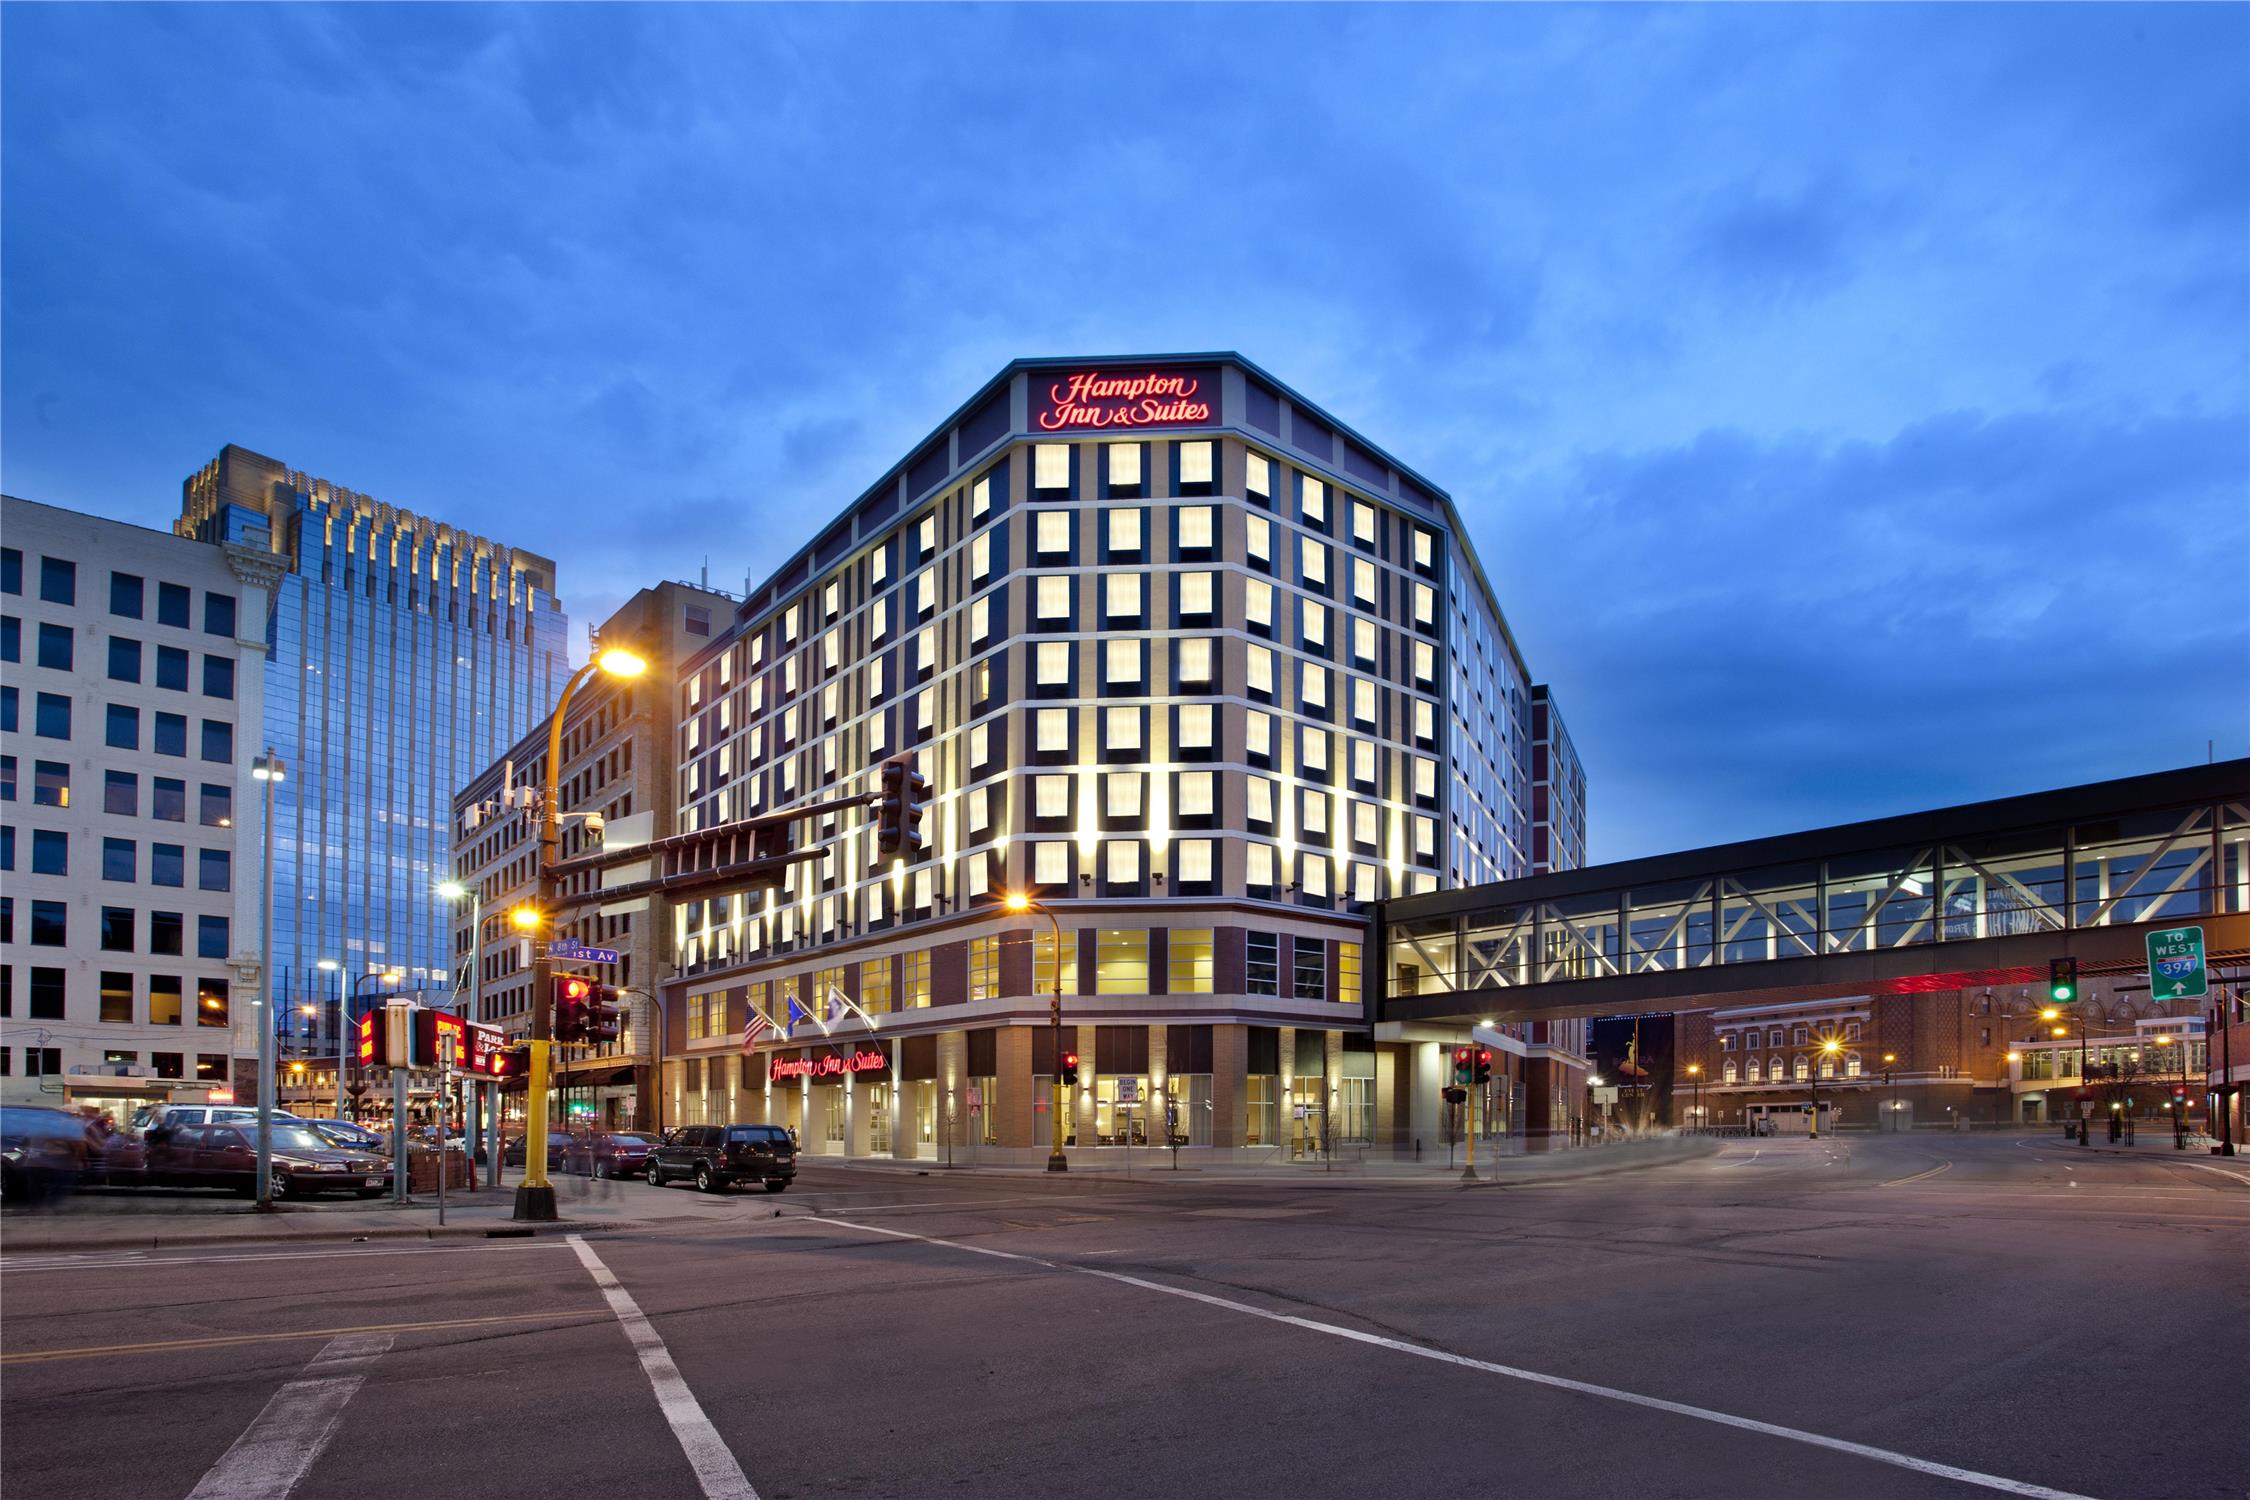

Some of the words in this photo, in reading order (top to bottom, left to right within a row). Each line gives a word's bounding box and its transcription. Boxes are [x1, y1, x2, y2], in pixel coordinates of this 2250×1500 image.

[1051, 372, 1198, 405] Hampton
[1040, 402, 1113, 429] Inn
[1113, 407, 1133, 425] &
[1130, 399, 1209, 424] Suites
[2165, 932, 2184, 943] TO
[597, 951, 614, 961] Av
[2155, 942, 2196, 956] WEST
[2163, 961, 2192, 975] 394
[477, 1030, 504, 1046] PARK
[768, 1057, 818, 1082] Hampton
[818, 1055, 845, 1076] Inn
[851, 1051, 884, 1072] Suites
